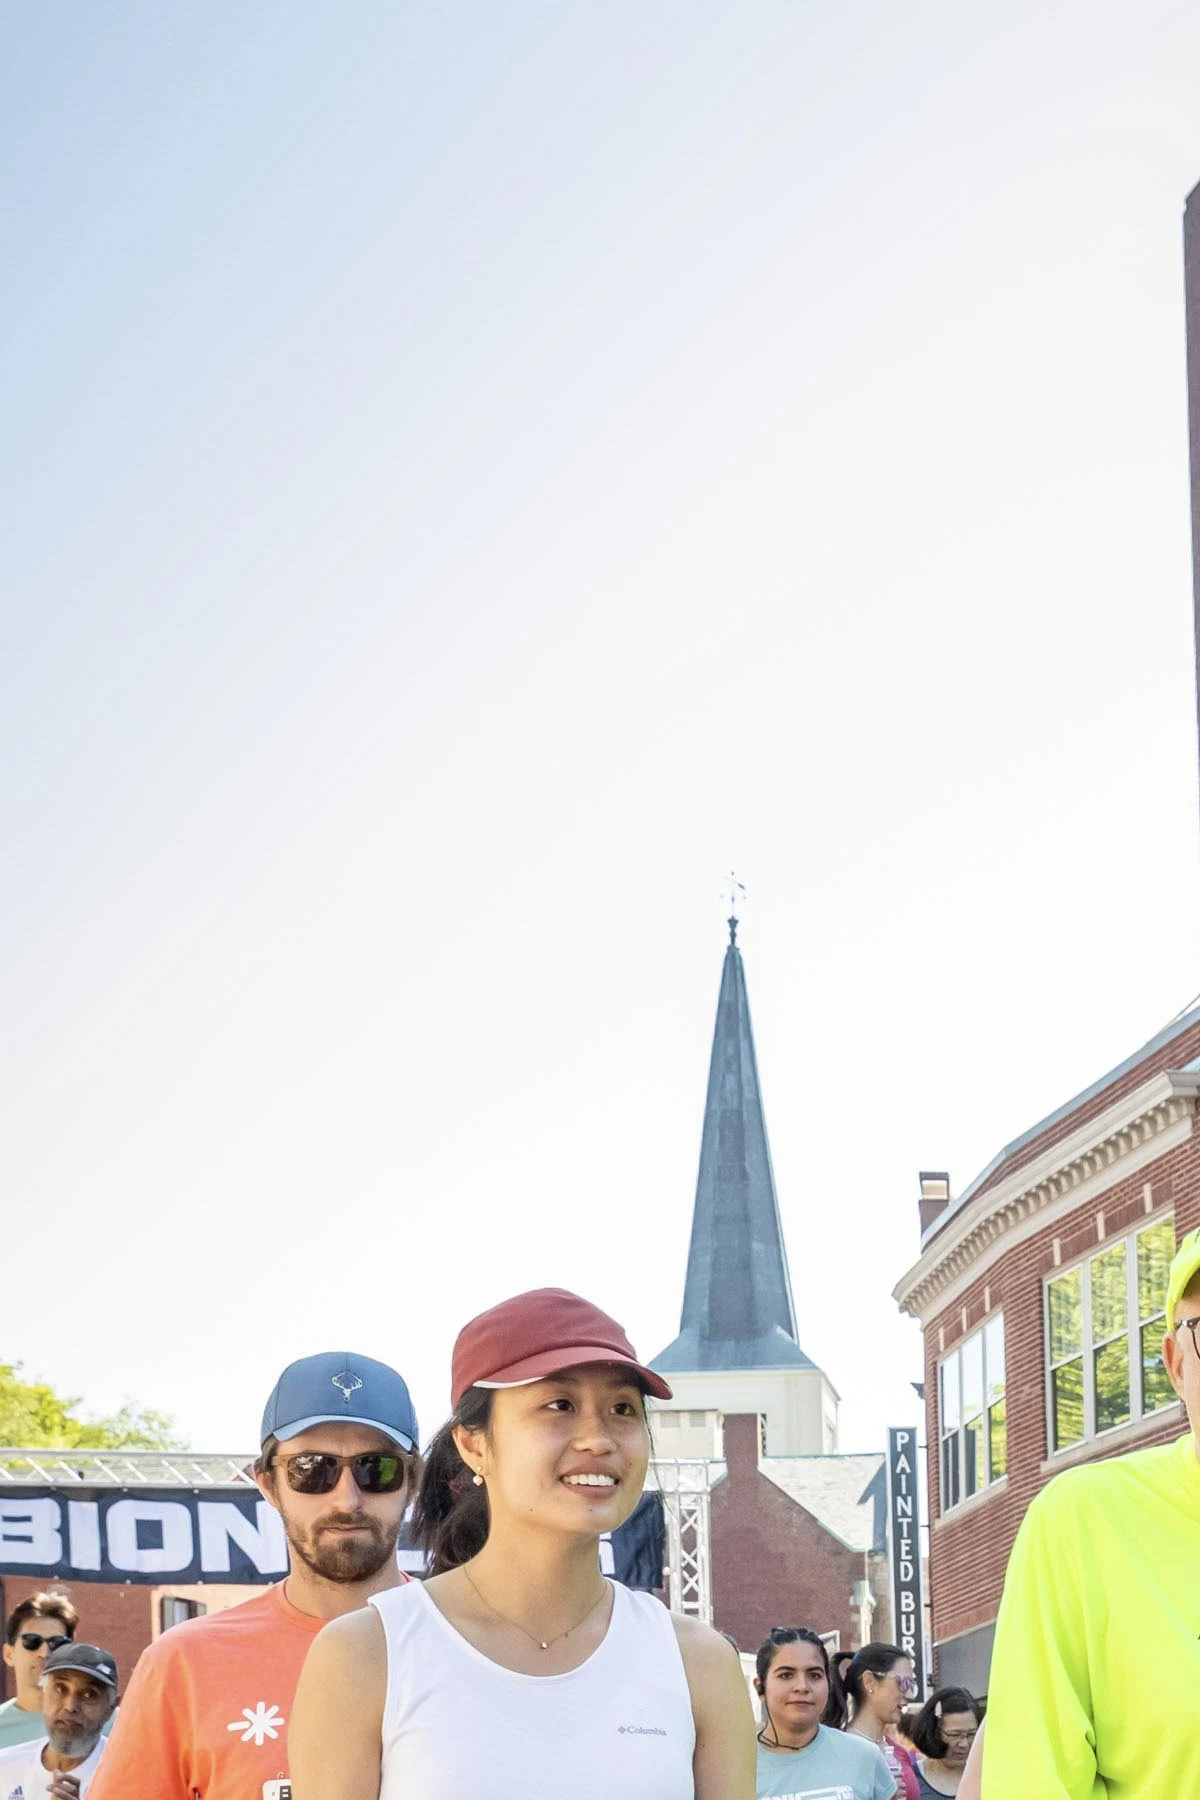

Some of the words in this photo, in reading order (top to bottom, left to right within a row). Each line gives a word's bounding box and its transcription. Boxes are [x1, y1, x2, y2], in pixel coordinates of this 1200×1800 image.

[0, 1497, 288, 1575] BION
[896, 1431, 914, 1583] PAINTED
[627, 1726, 667, 1736] Columbia
